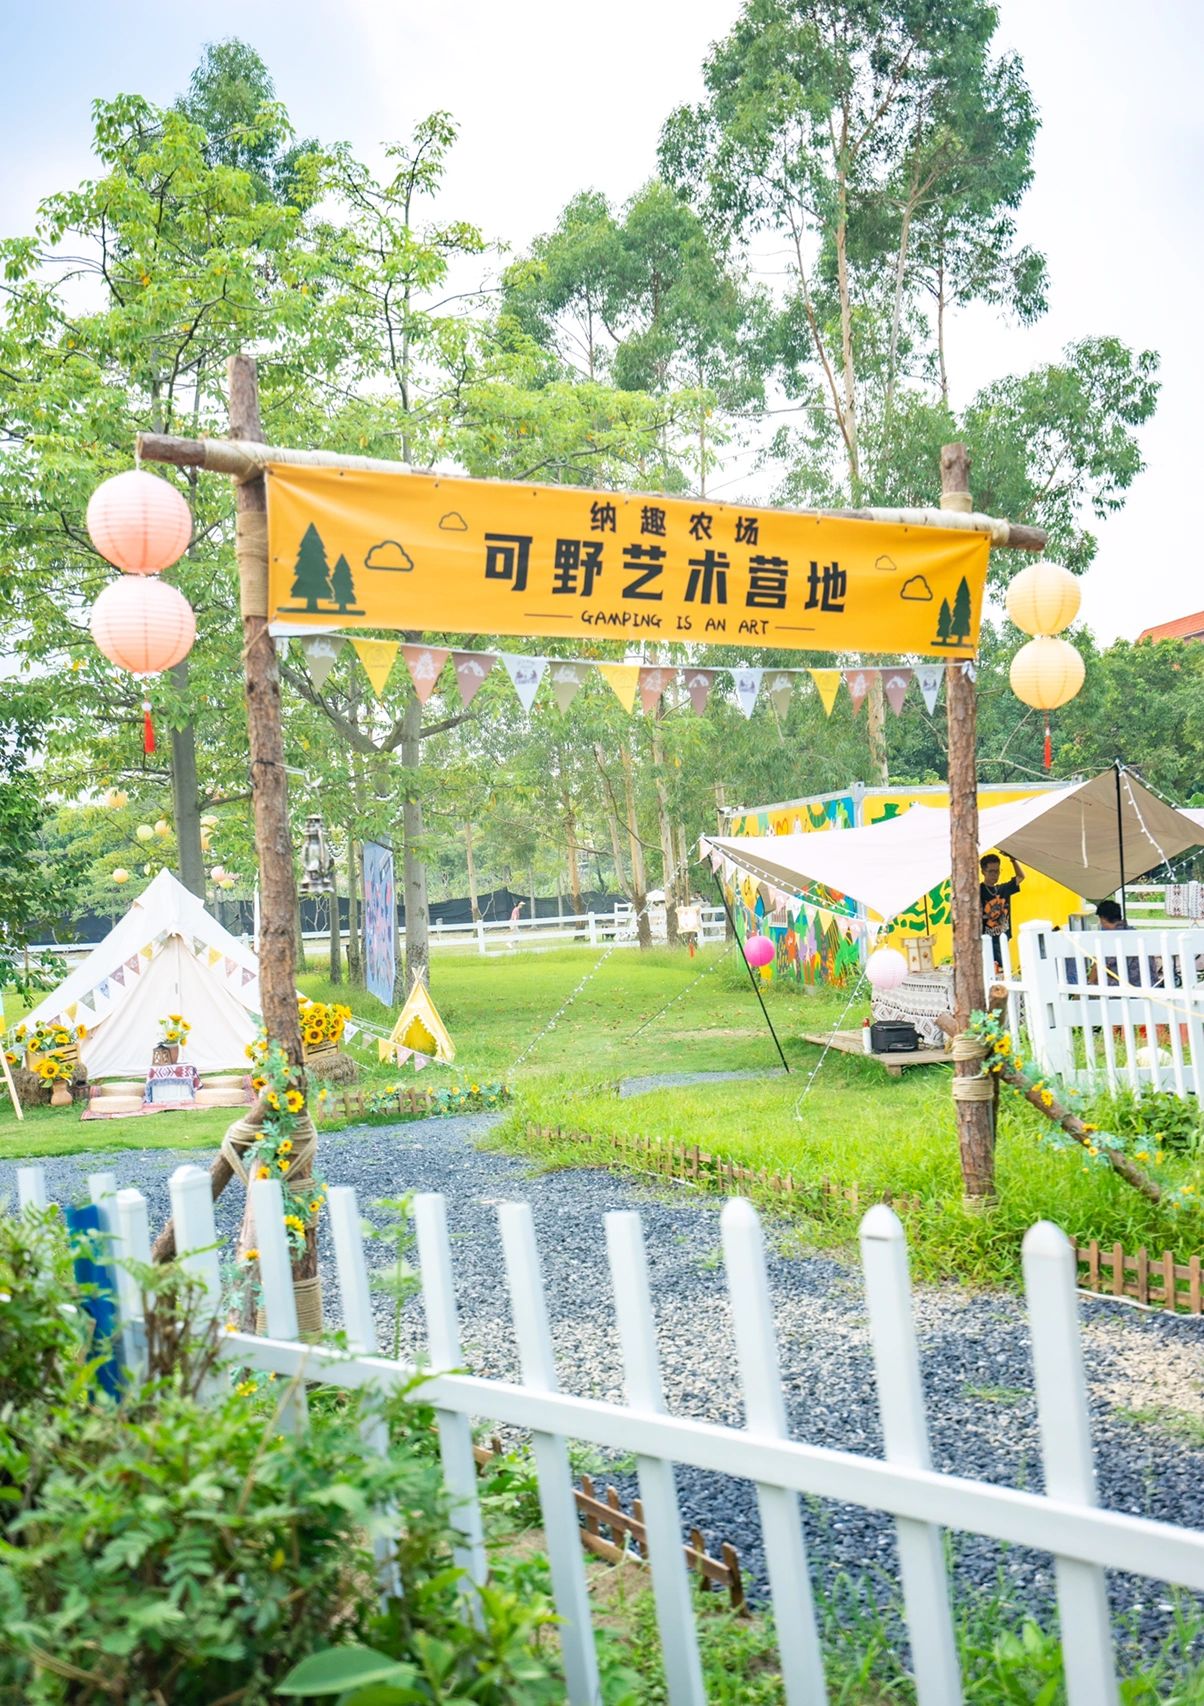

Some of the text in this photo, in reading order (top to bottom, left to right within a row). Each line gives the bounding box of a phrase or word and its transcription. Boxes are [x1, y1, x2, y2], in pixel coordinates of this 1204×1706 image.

[590, 501, 759, 546] 纳趣农场
[484, 532, 847, 613] 可野艺术营地
[581, 610, 769, 635] GAMPING IS AN ART
